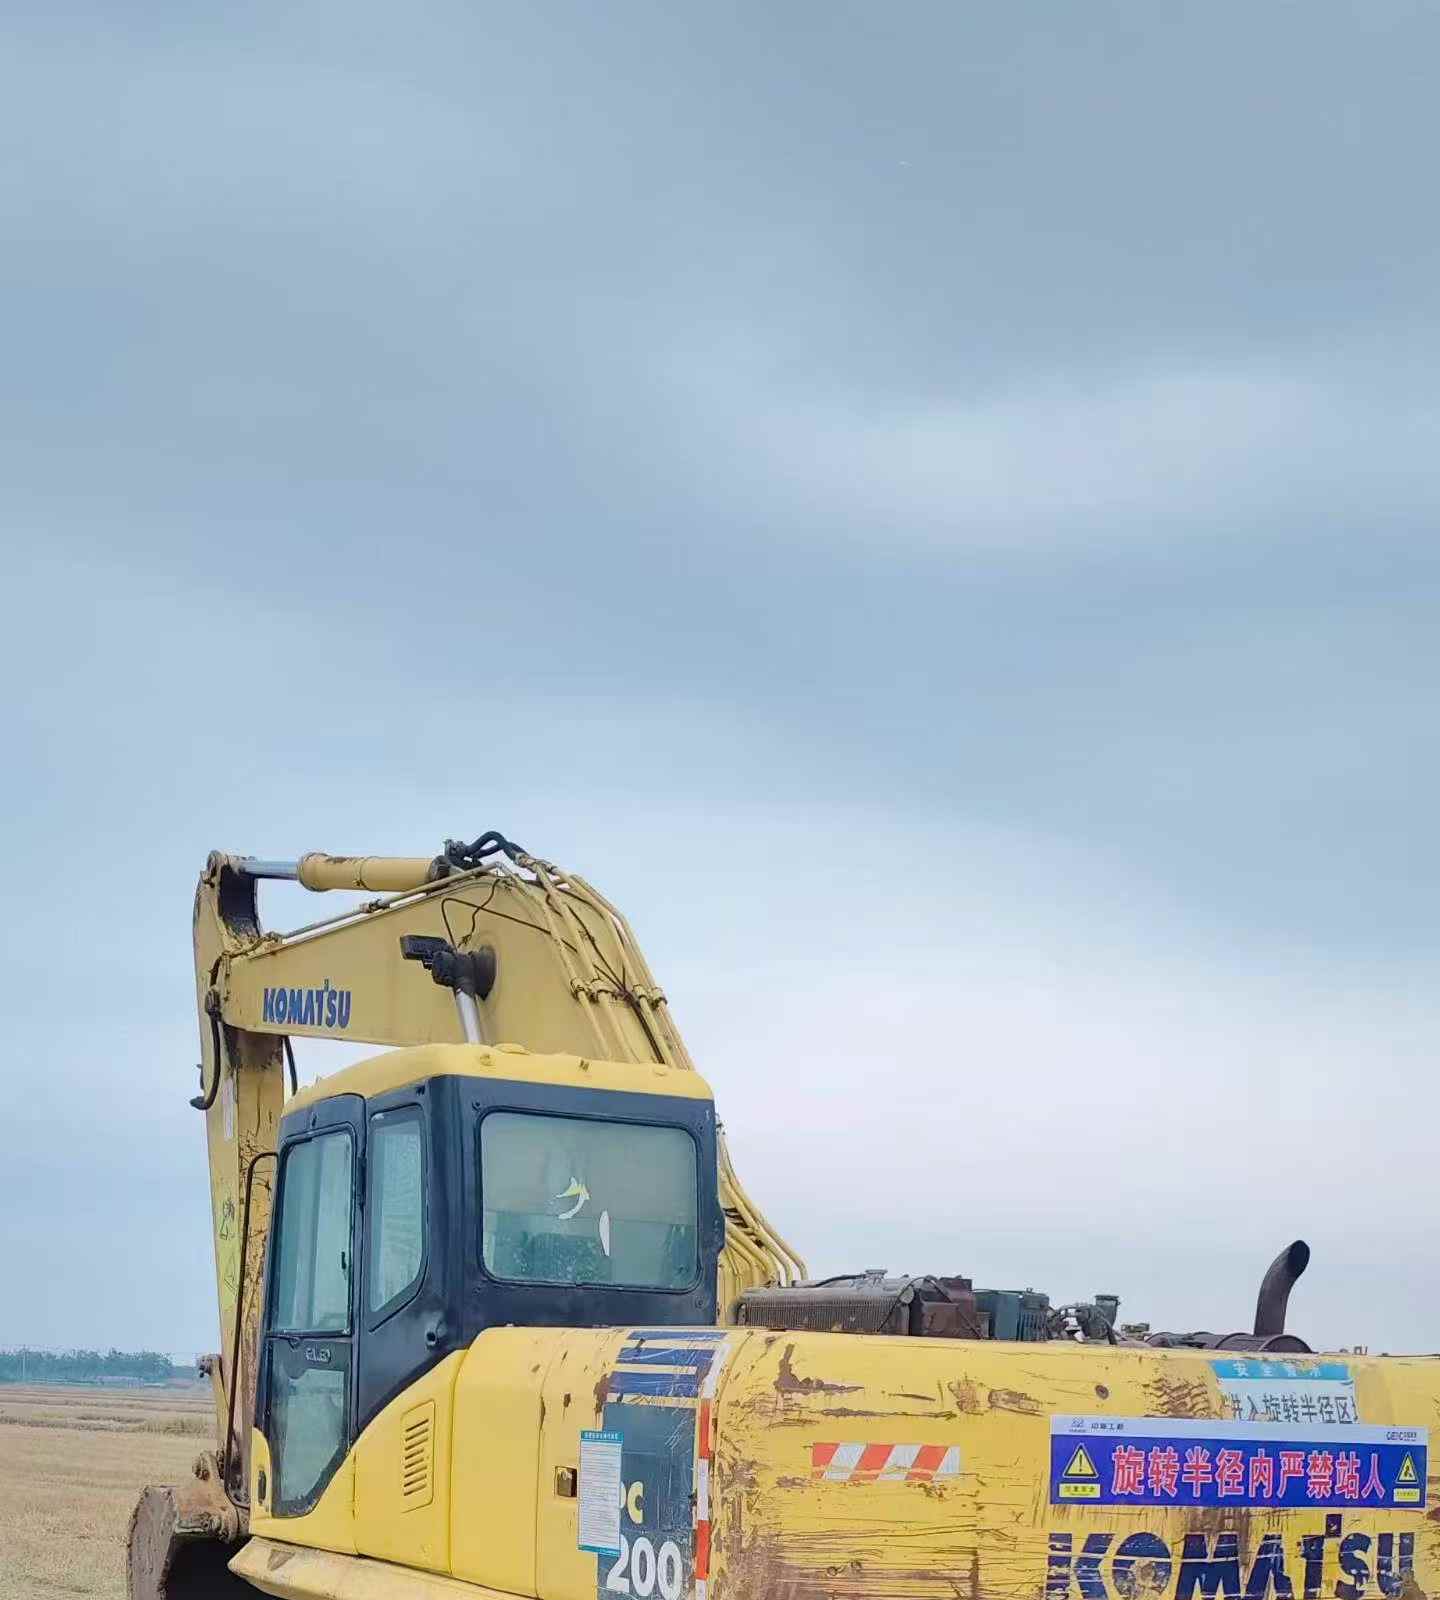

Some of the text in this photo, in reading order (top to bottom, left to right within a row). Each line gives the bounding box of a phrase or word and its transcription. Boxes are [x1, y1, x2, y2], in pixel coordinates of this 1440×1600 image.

[262, 979, 351, 1029] KOMATSU
[1111, 1445, 1386, 1500] 旋转半径内严禁站人
[620, 1481, 644, 1525] C
